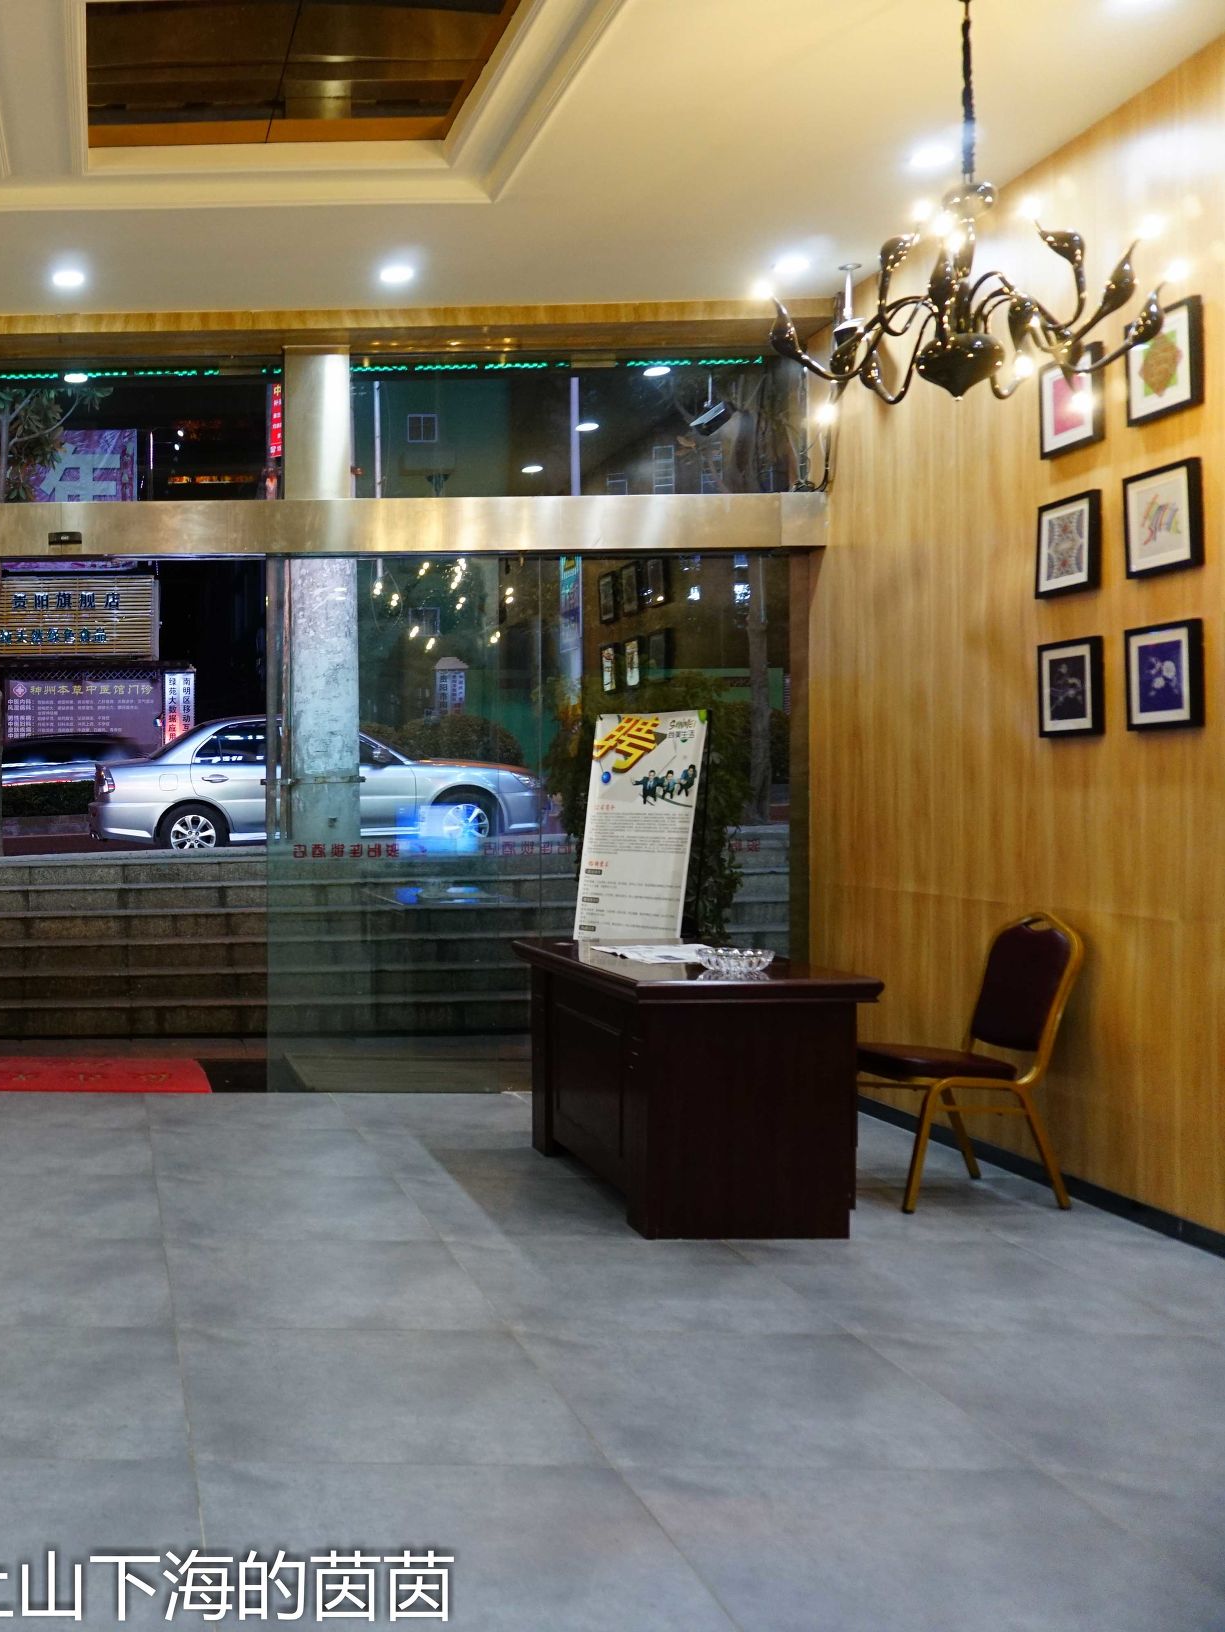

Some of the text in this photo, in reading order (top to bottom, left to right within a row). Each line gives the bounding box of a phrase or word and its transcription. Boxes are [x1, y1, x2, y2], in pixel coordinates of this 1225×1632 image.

[12, 592, 121, 611] 贵阳旗舰店
[30, 684, 154, 696] 神州本草中医馆门诊
[592, 716, 661, 774] 聘
